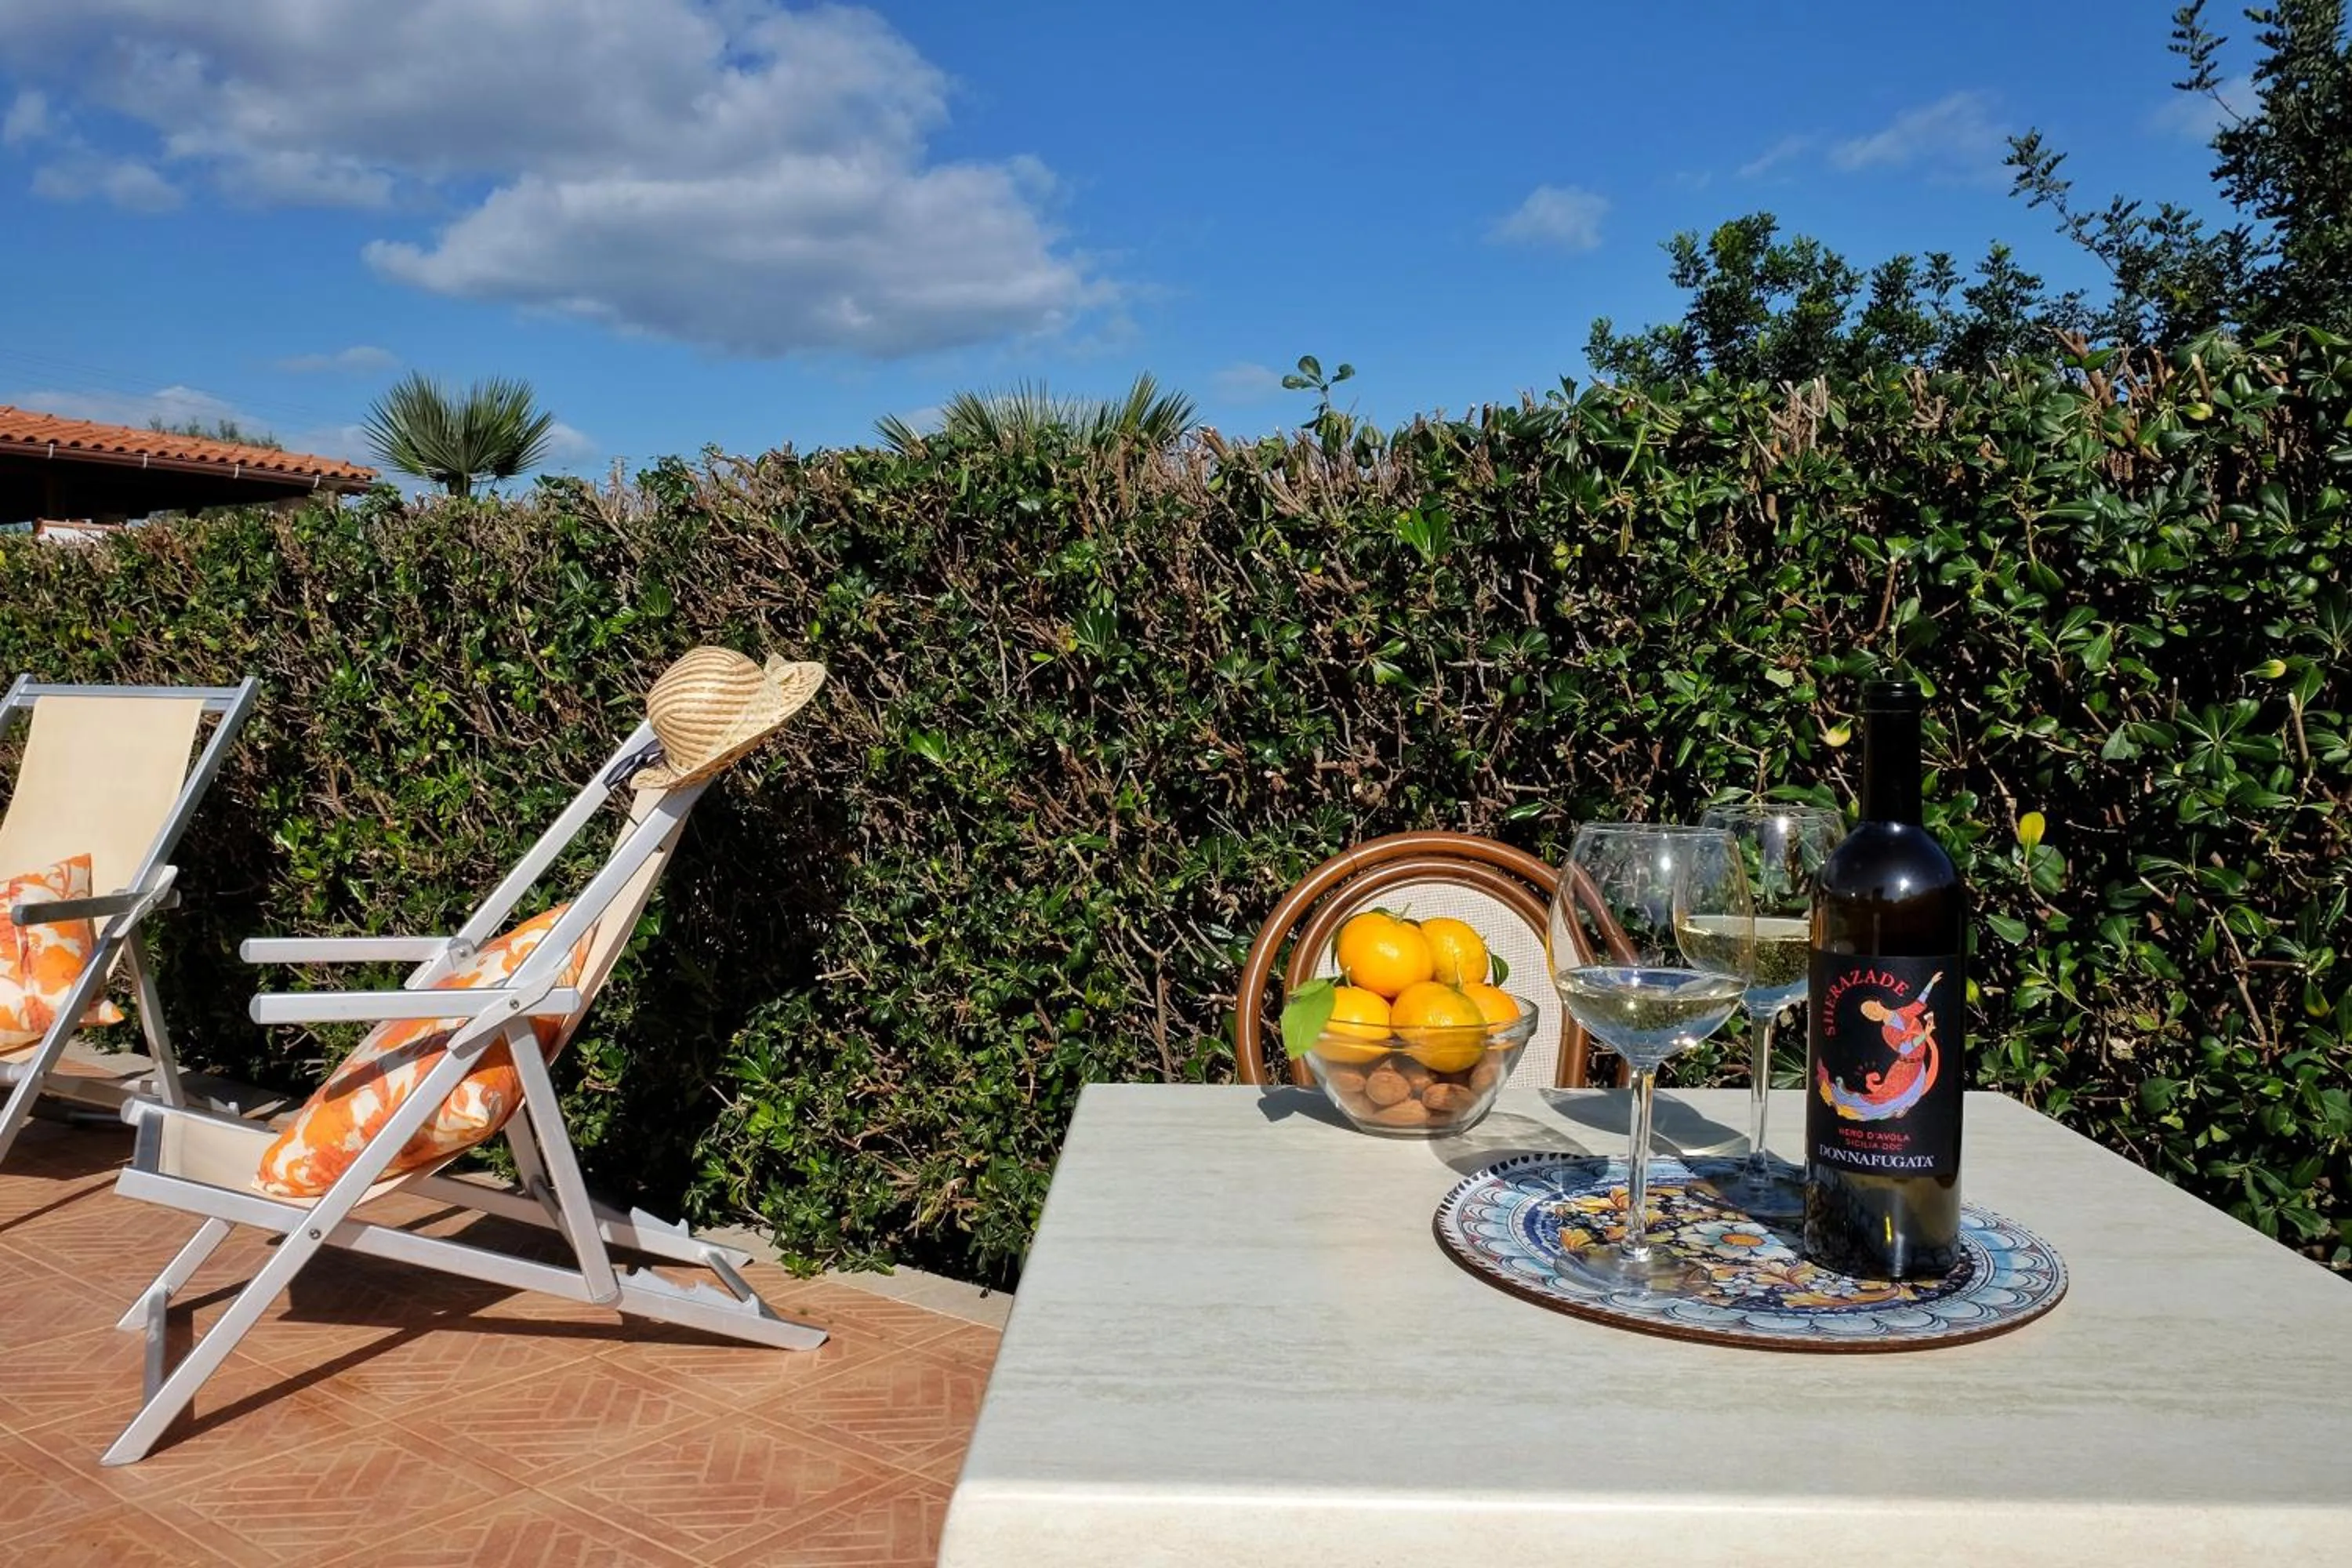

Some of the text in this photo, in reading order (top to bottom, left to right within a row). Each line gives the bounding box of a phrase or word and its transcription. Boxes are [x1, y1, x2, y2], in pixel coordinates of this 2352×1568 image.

[1823, 968, 1911, 1036] SHERAZADE
[1838, 1127, 1911, 1142] NERO D'AVOLA
[1845, 1138, 1878, 1149] SICILIA
[1819, 1143, 1934, 1167] DONNAFUGATA
